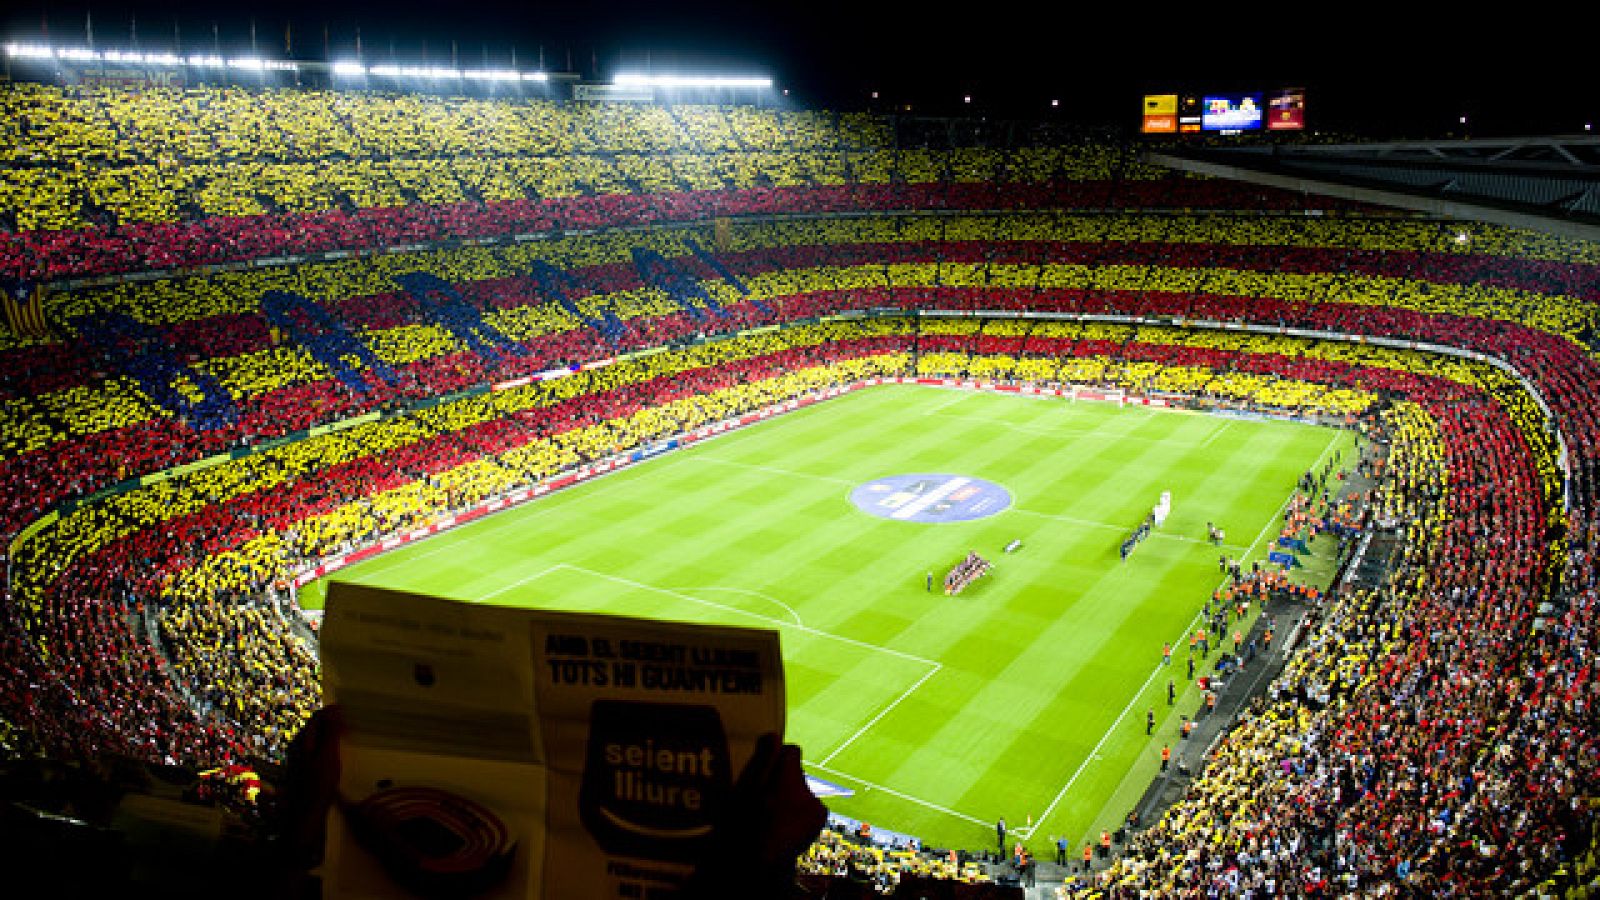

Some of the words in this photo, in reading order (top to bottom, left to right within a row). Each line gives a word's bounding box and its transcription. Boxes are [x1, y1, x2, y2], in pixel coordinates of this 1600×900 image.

[547, 659, 608, 686] TOTS
[612, 662, 636, 688] HI
[605, 738, 714, 777] seient
[614, 768, 702, 811] lliure
